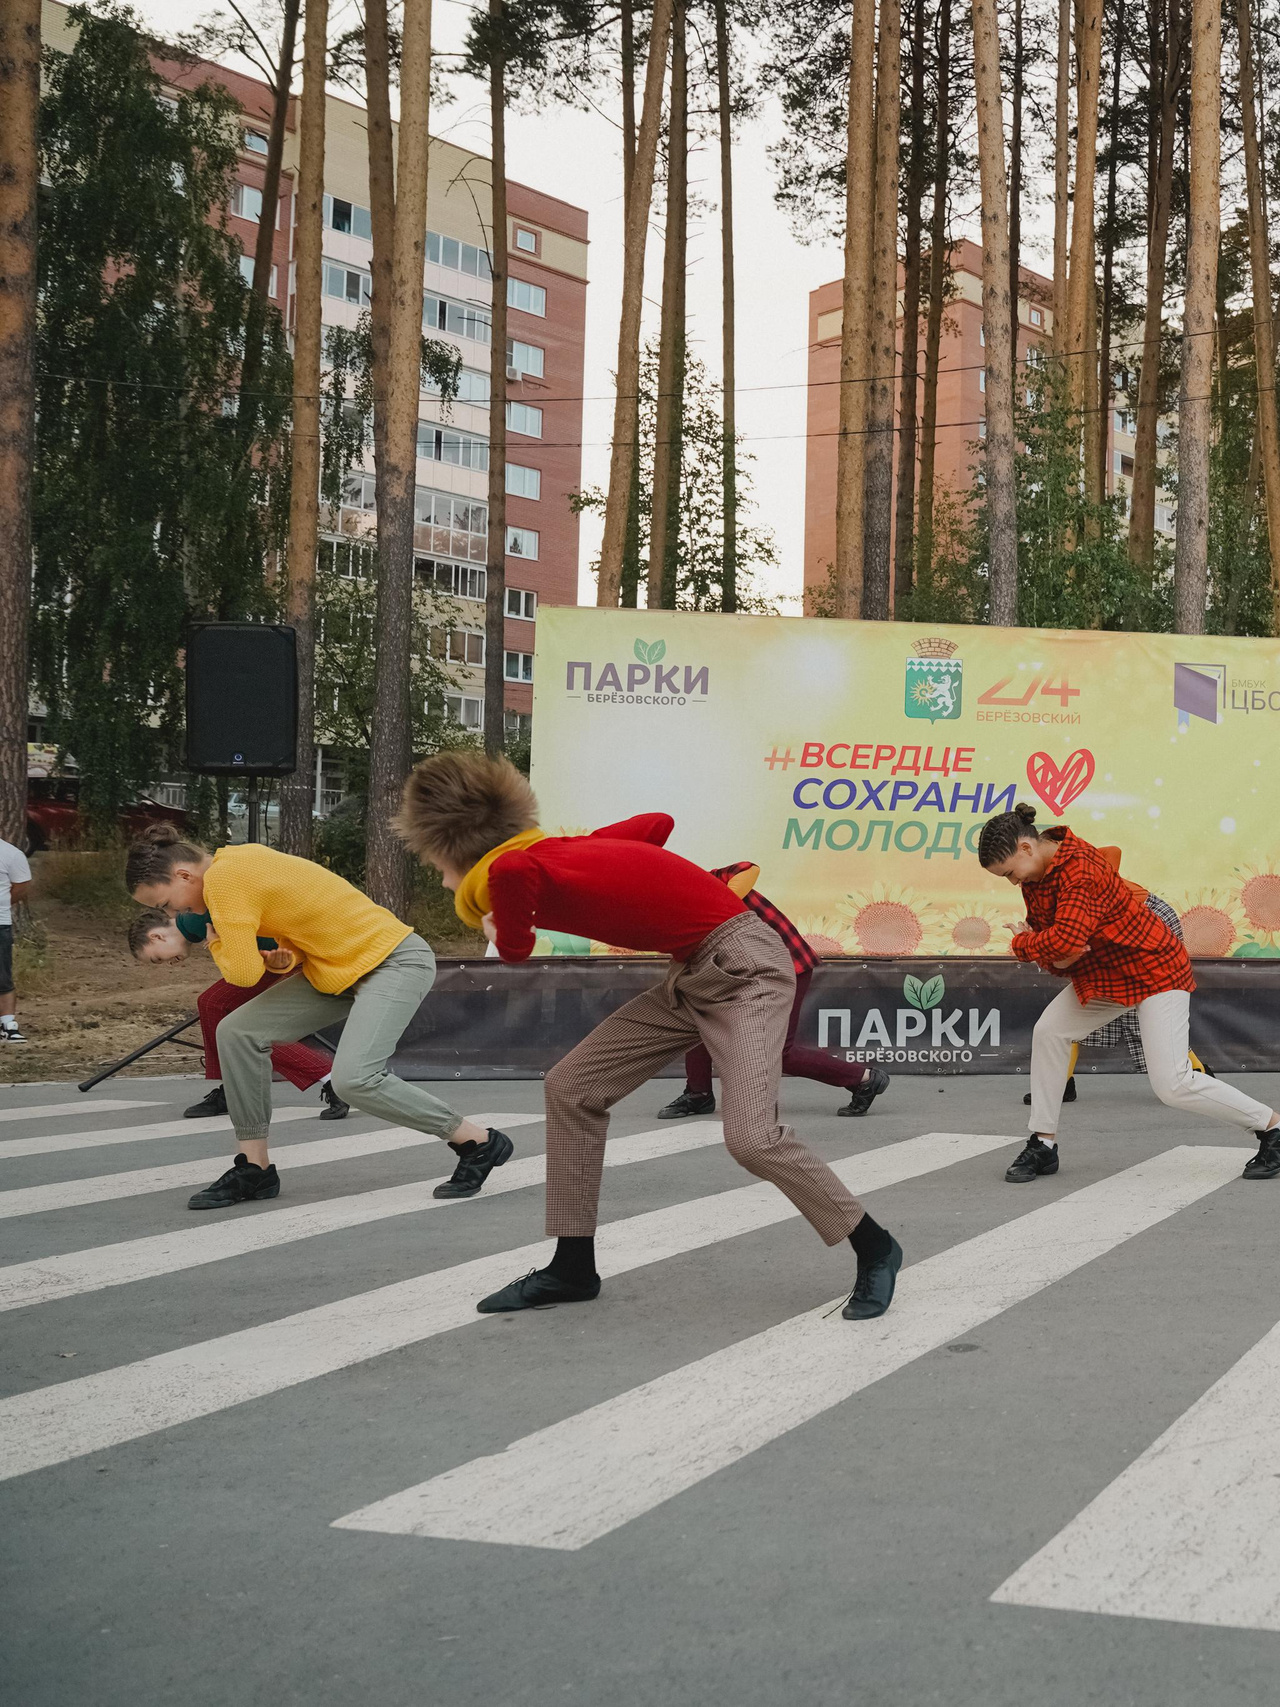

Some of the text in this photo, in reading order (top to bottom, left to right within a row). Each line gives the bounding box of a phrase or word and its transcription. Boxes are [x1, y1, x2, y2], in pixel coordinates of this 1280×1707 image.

[566, 661, 709, 695] ПАРКИ
[1231, 678, 1267, 689] БМБУК
[587, 692, 686, 706] БЕРЁЗОВСКОГО
[976, 709, 1081, 725] БЕРЁЗОВСКИЙ
[764, 742, 976, 777] #ВСЕРДЦЕ
[792, 777, 1017, 814] СОХРАНИ
[818, 1008, 1000, 1047] ПАРКИ
[845, 1047, 973, 1063] БЕРЁЗОВСКОГО
